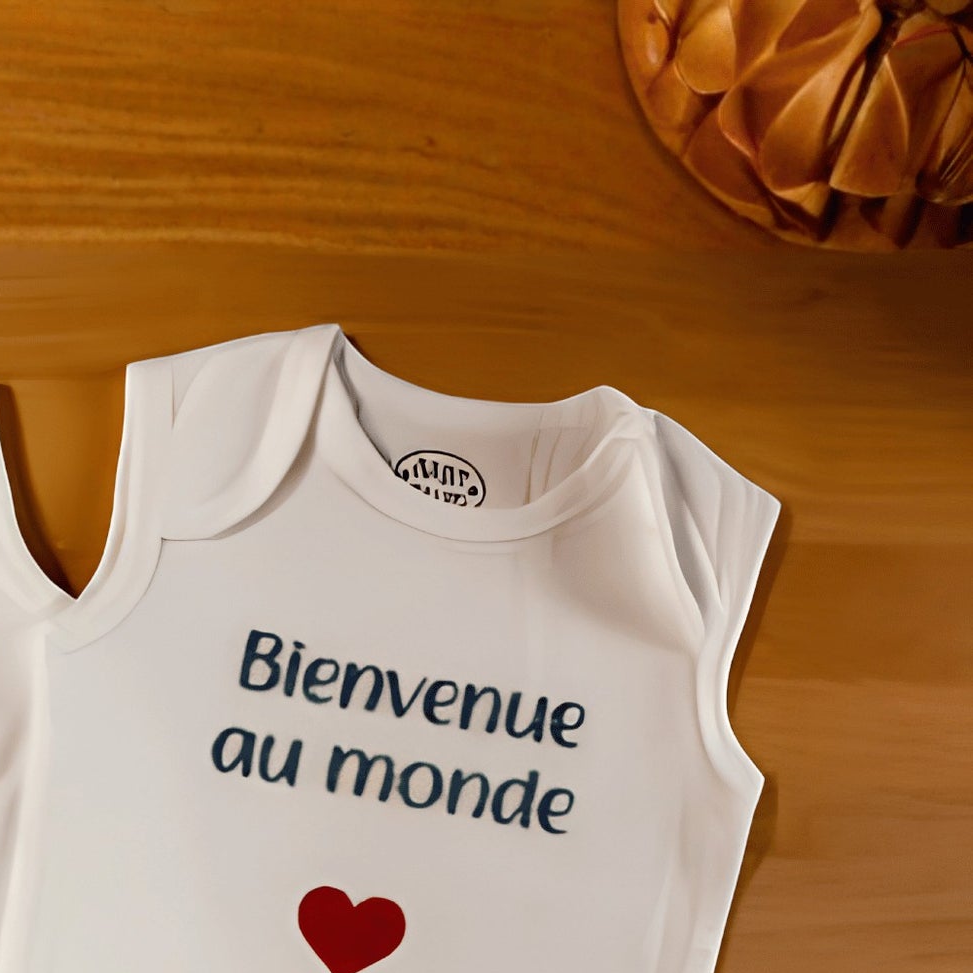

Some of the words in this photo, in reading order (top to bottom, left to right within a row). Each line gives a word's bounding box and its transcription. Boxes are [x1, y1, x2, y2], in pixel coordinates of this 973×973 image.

[239, 629, 586, 748] Bienvenue
[211, 726, 303, 787] au
[326, 744, 575, 835] monde
